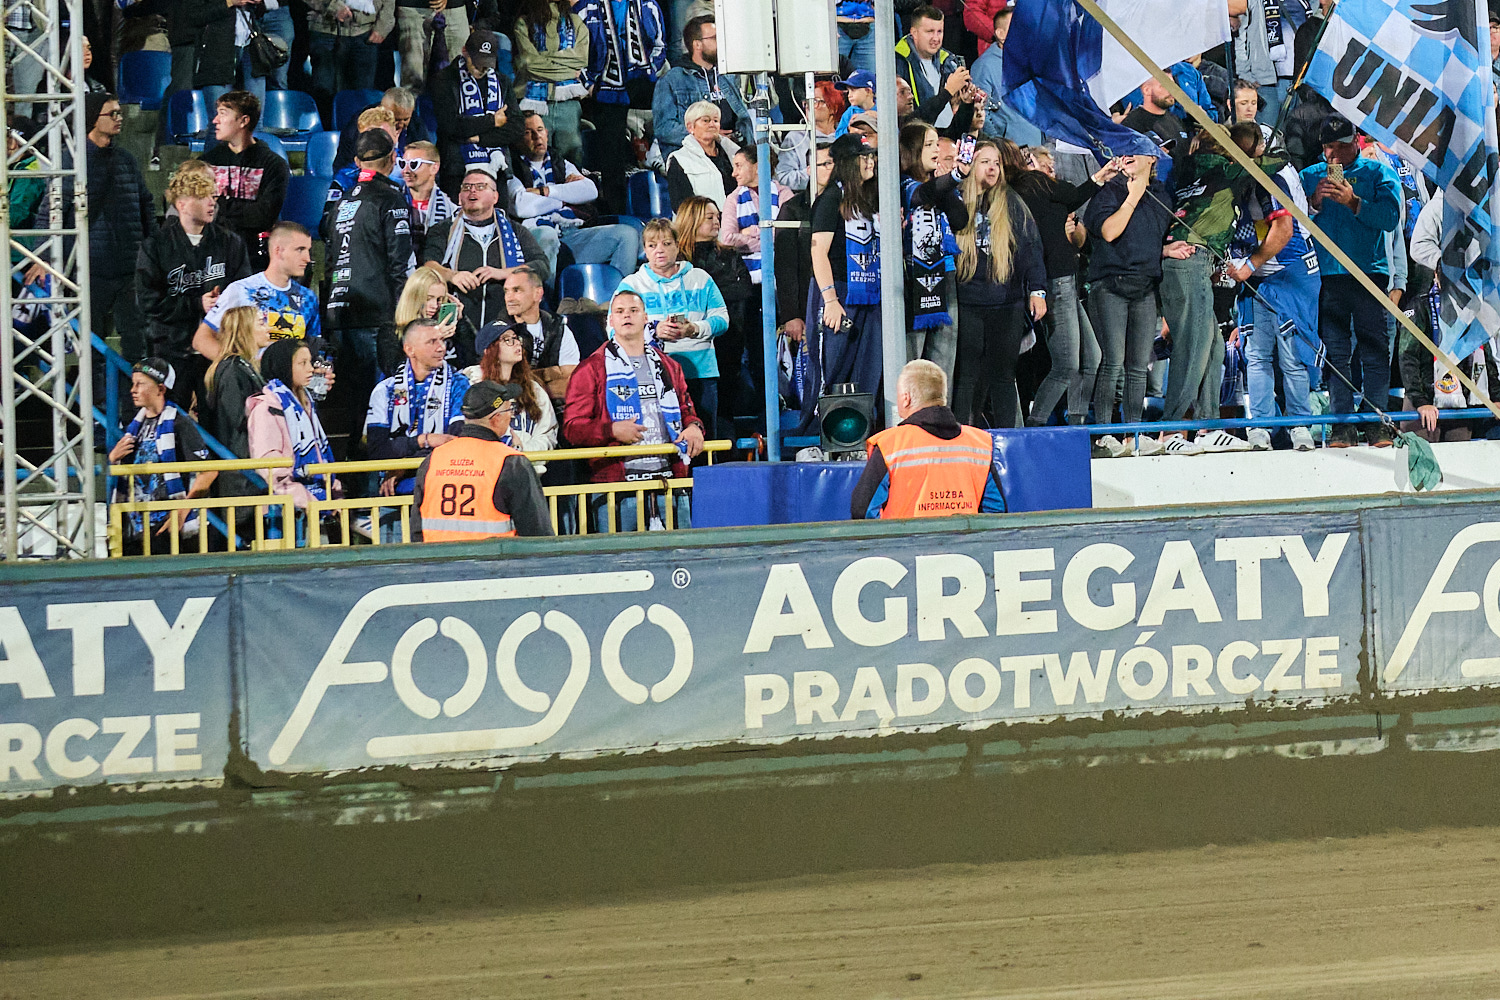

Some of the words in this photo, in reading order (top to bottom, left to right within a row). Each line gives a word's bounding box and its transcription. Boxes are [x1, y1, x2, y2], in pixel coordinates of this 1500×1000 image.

[1331, 36, 1458, 169] UNIA
[435, 467, 486, 478] INFORMACYJNA
[449, 458, 475, 467] SŁUŻBA
[440, 483, 476, 517] 82
[917, 500, 974, 512] INFORMACYJNA
[929, 489, 965, 500] SŁUŻBA
[742, 531, 1351, 654] AGREGATY
[743, 630, 1343, 738] PRĄDOTWÓRCZE
